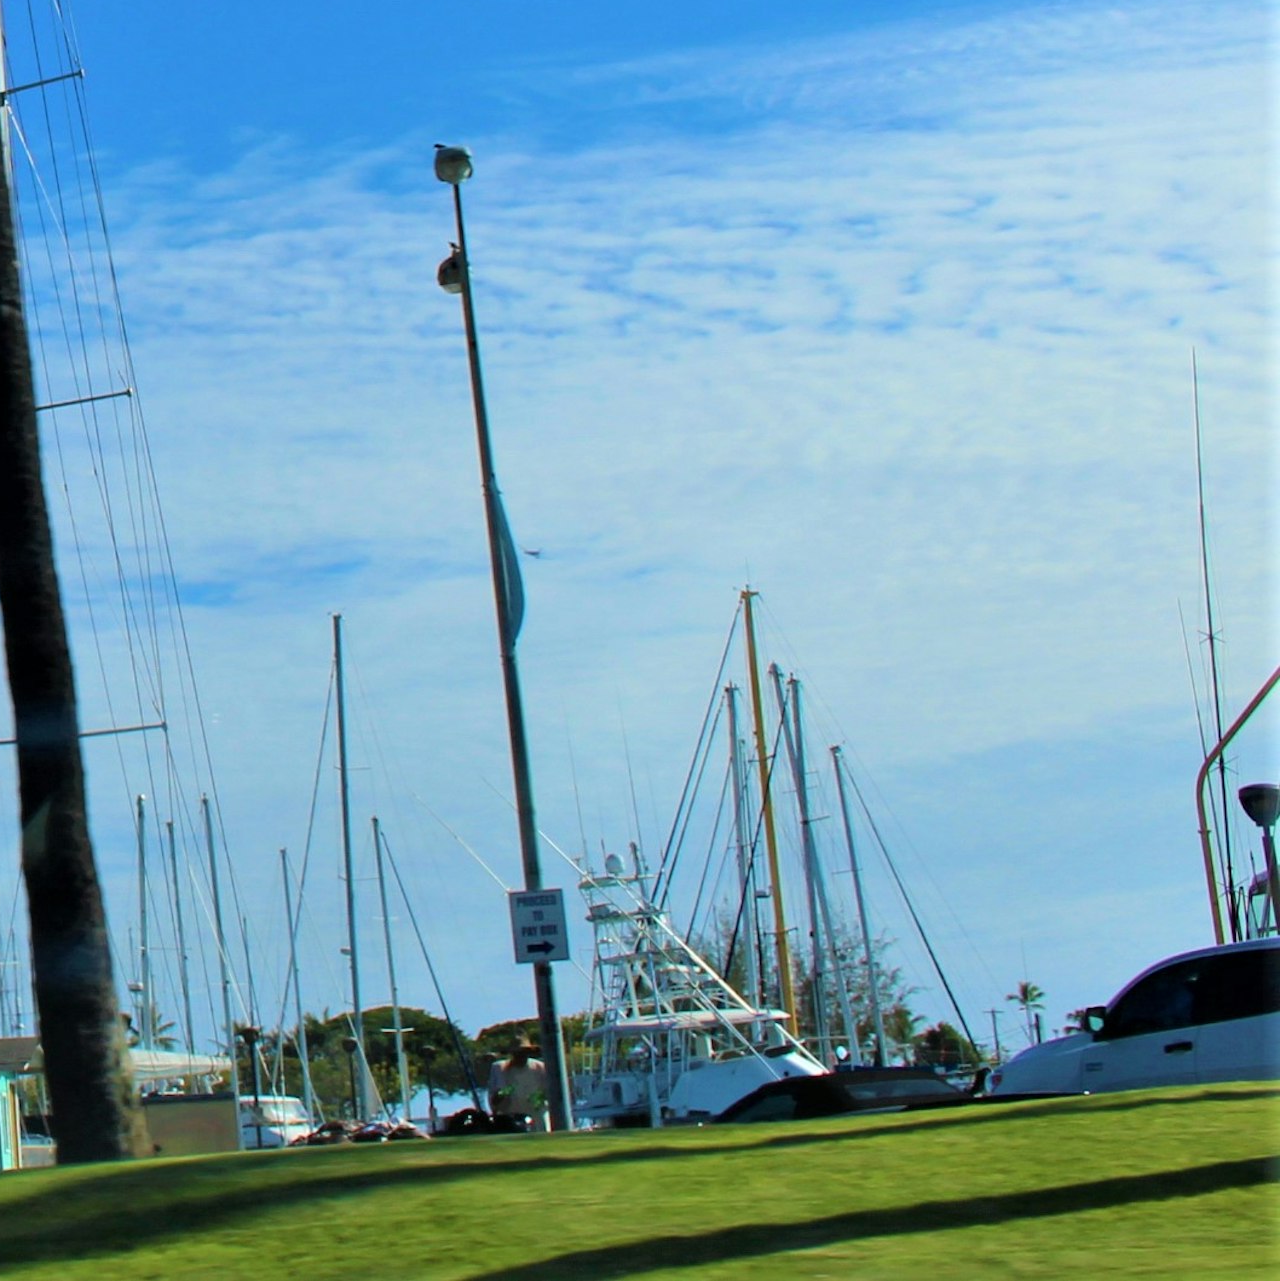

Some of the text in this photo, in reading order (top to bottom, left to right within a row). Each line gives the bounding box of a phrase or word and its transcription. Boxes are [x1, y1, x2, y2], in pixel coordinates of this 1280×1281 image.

[516, 894, 557, 907] PROCEED
[532, 910, 544, 921] TO
[522, 926, 538, 937] PAY
